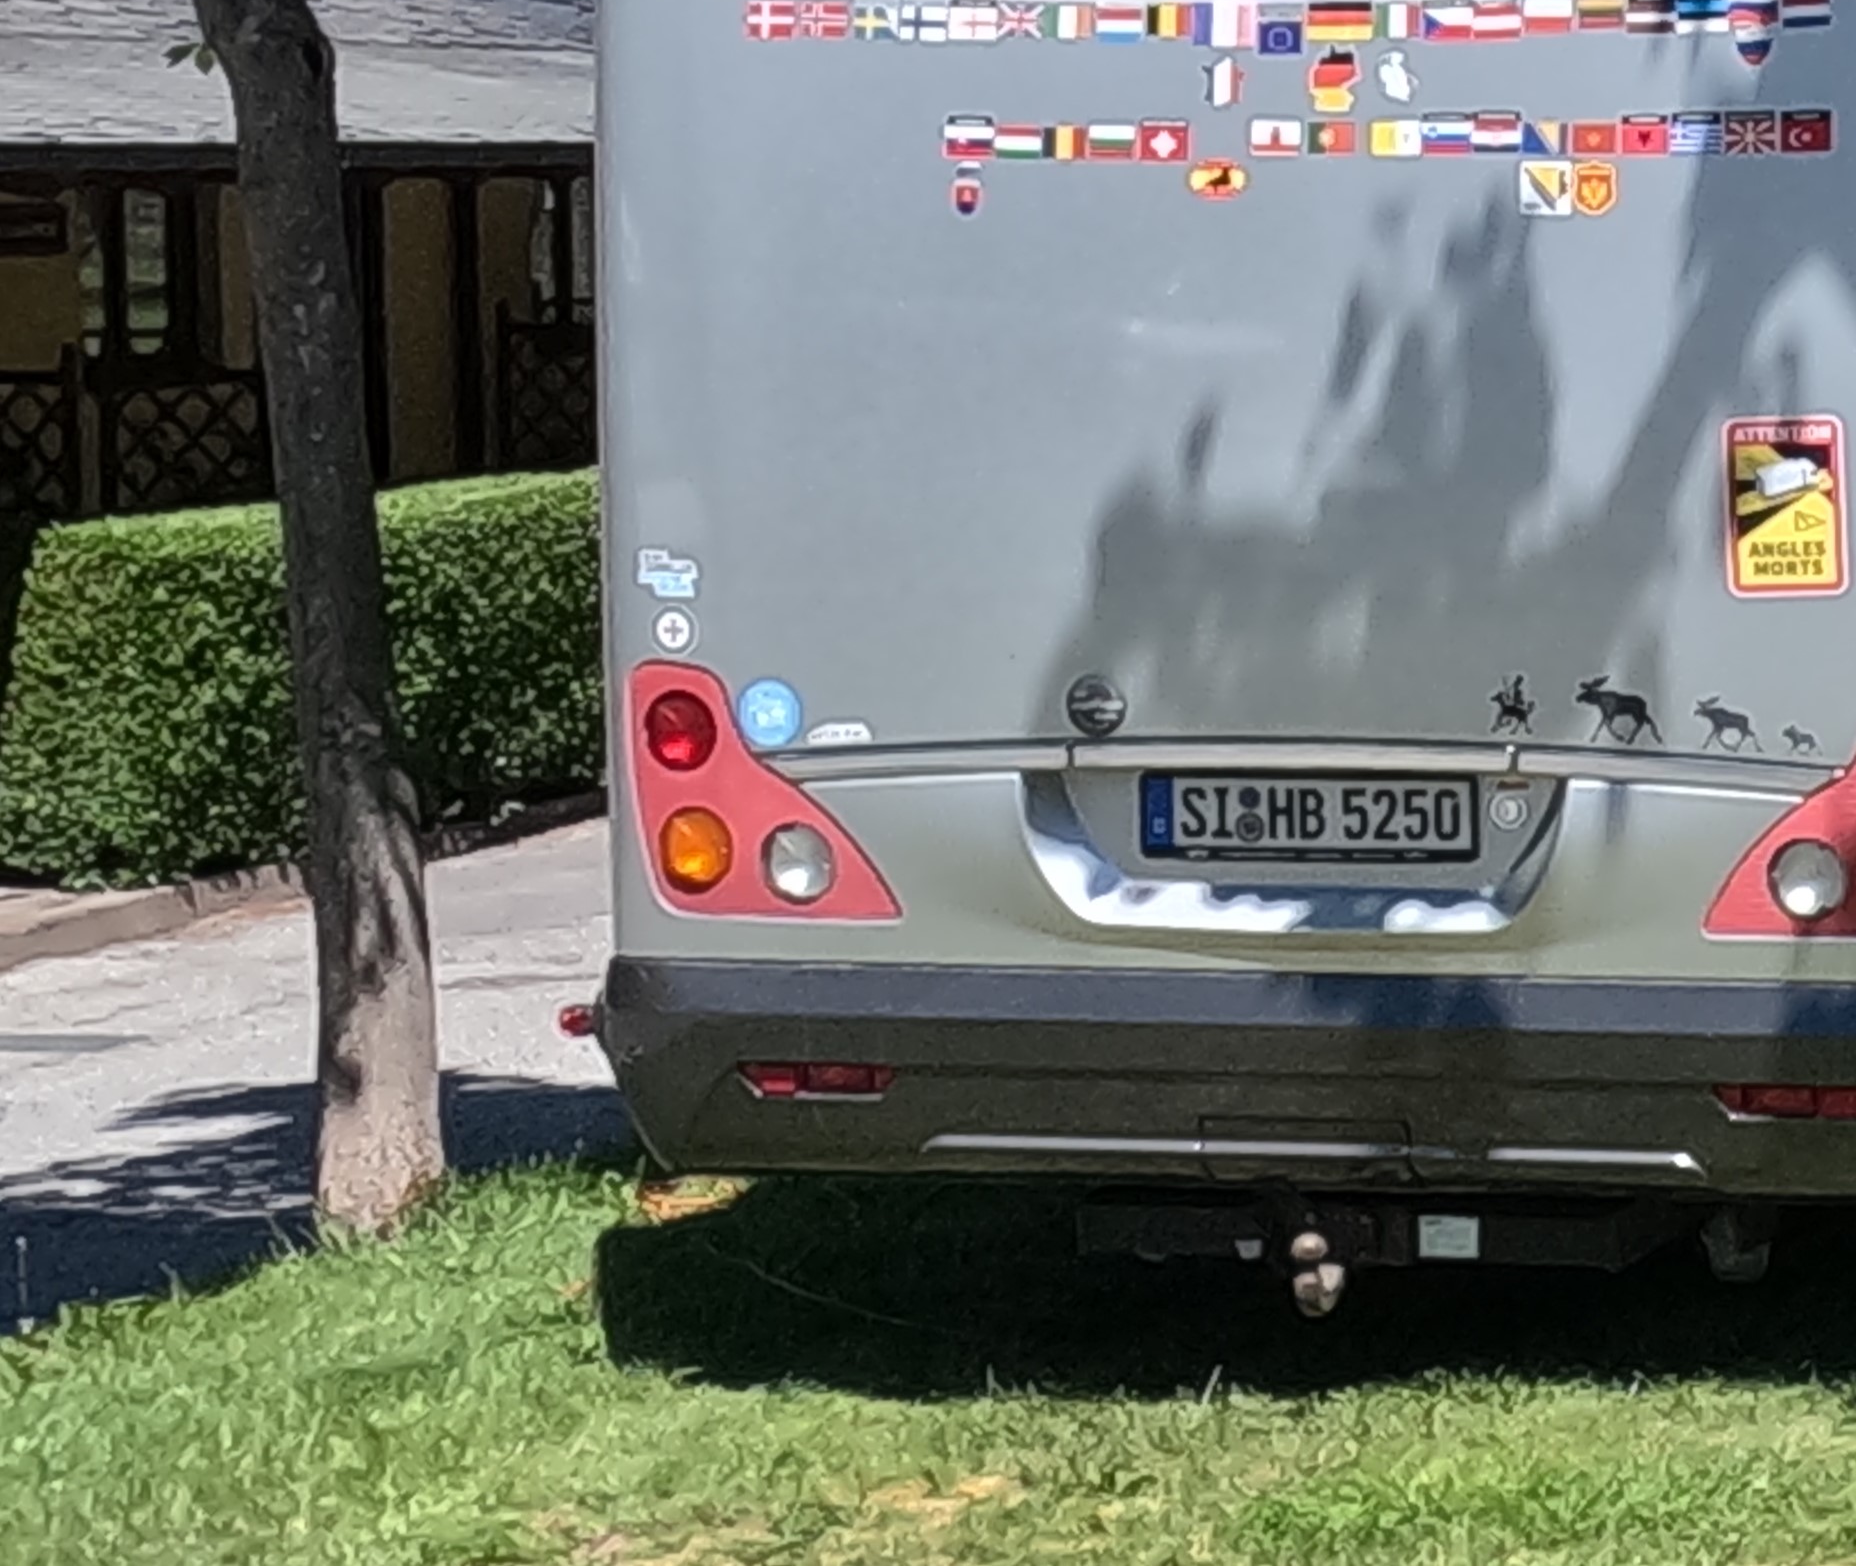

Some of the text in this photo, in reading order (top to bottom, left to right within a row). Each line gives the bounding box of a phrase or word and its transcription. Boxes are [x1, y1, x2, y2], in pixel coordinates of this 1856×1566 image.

[1733, 424, 1832, 443] ATTENTION
[1748, 540, 1827, 558] ANGLES
[1753, 559, 1825, 576] MORTS
[1180, 786, 1461, 842] SI HB 5250
